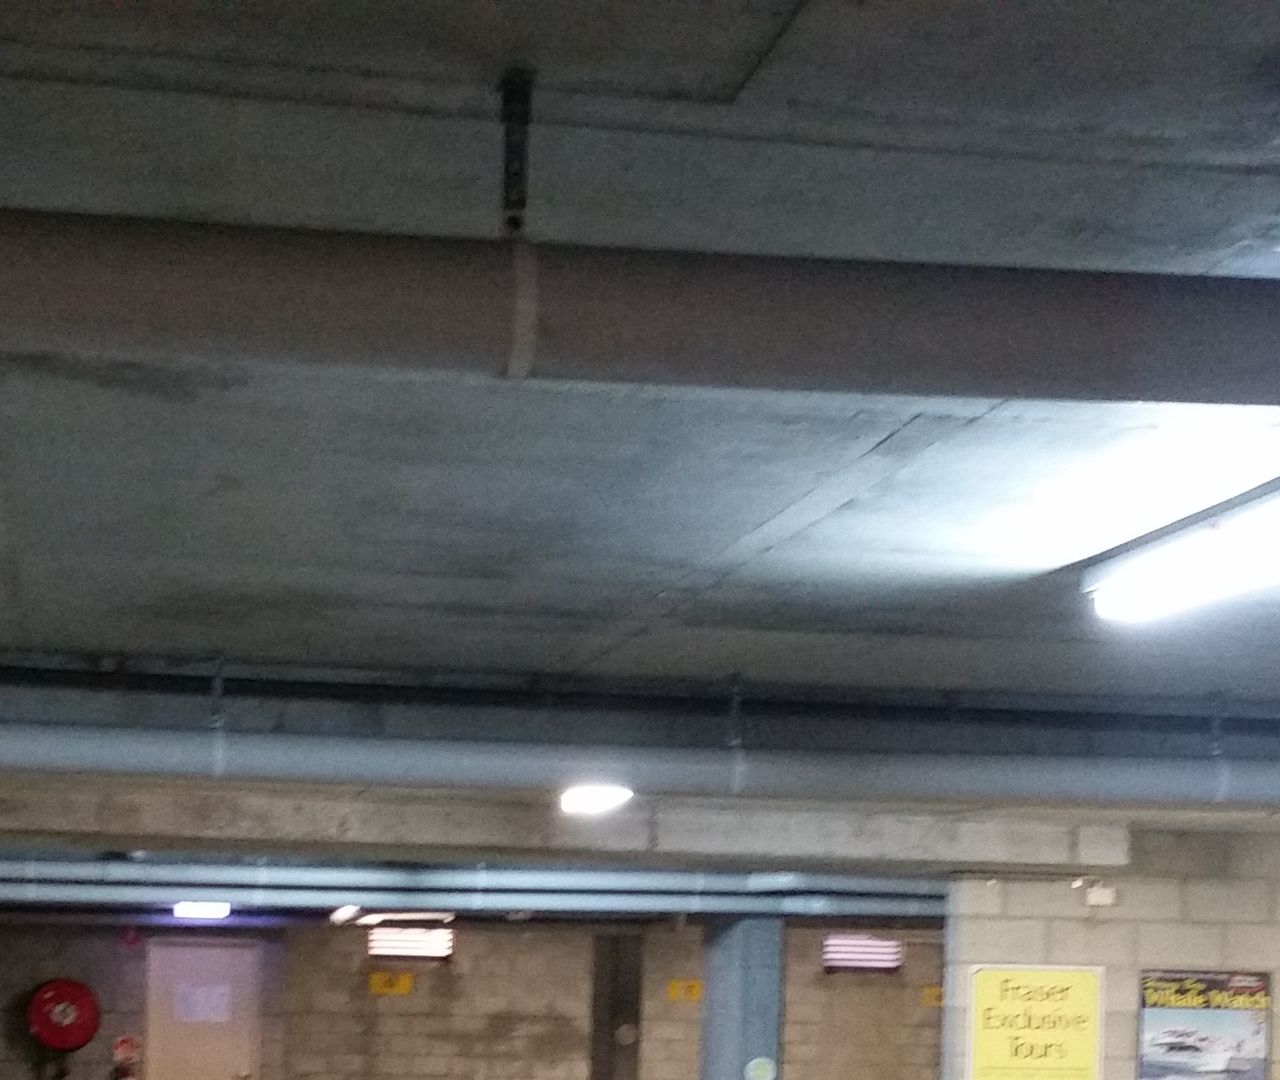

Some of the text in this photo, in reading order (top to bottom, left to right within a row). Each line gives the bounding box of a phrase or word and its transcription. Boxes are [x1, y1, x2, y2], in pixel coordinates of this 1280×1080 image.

[999, 978, 1072, 1002] Fraser
[982, 1007, 1089, 1031] Exclusive
[1008, 1036, 1068, 1059] Tours
